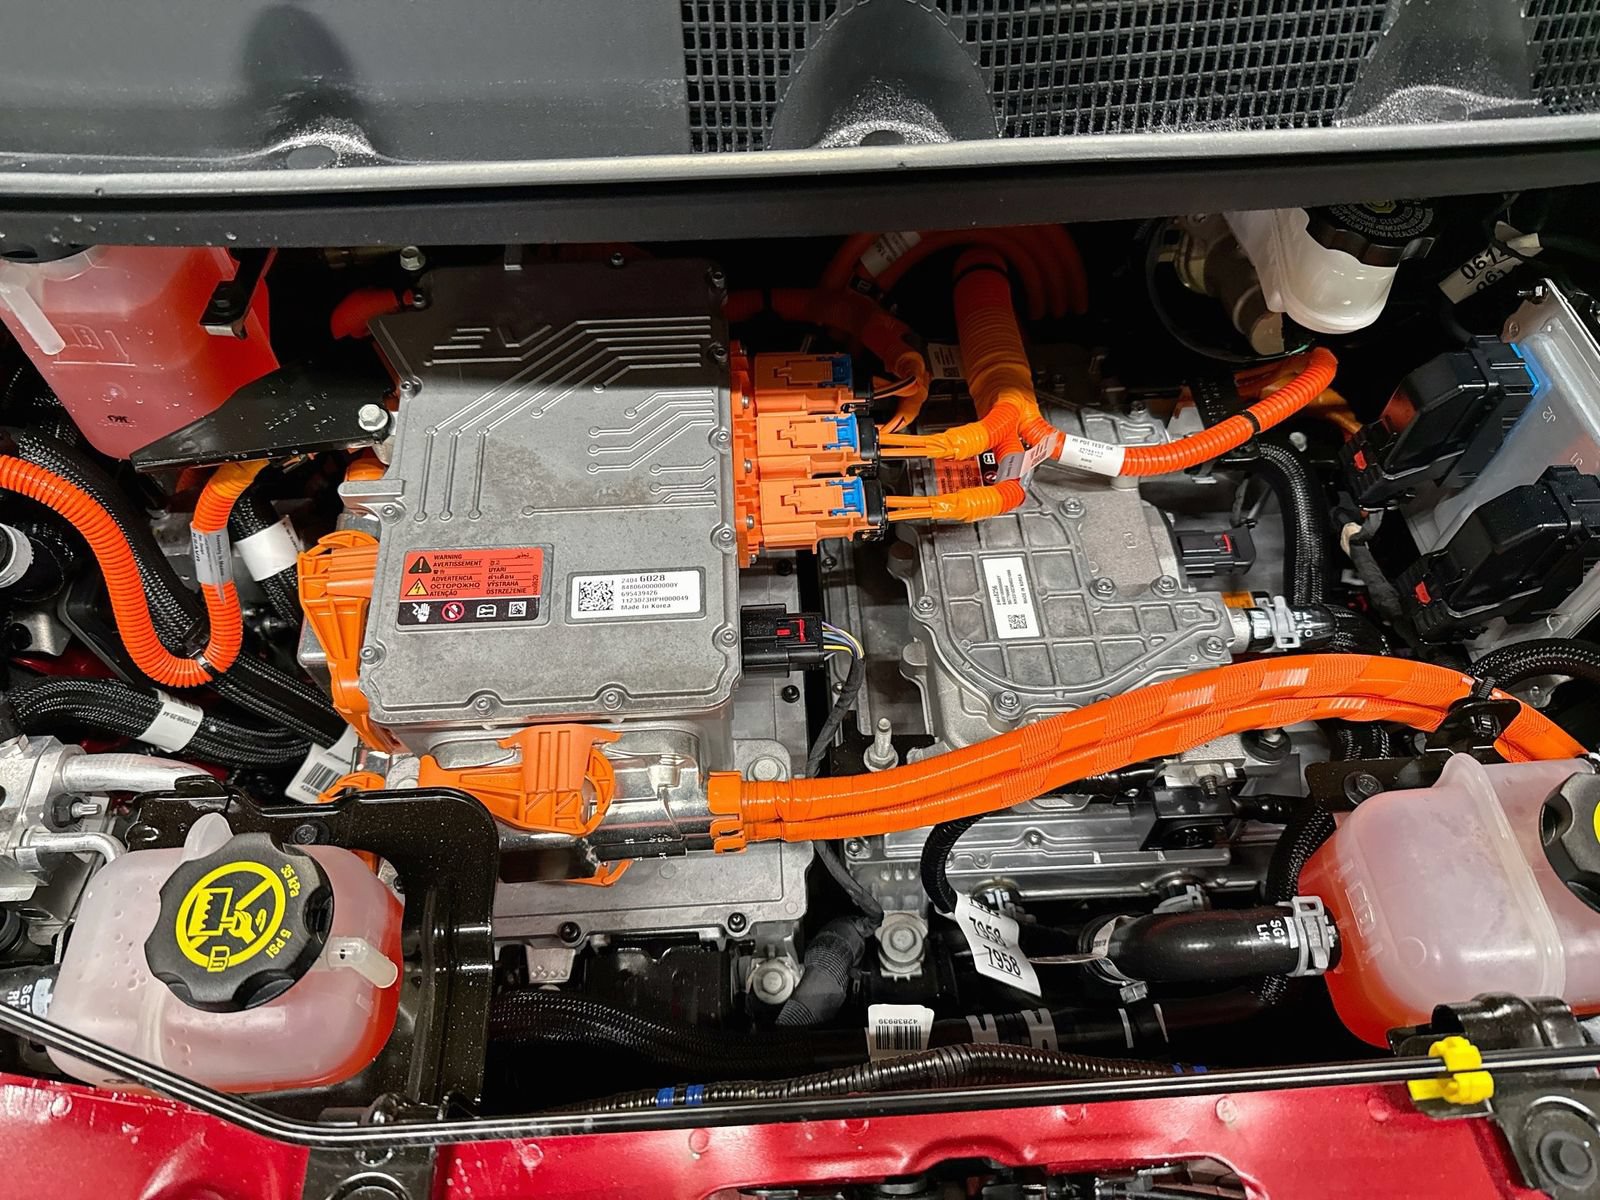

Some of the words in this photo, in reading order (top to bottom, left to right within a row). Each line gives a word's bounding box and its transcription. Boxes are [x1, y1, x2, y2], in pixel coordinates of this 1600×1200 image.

[433, 560, 482, 568] AVERTISSEMENT
[640, 574, 666, 582] 6028
[280, 864, 295, 878] 35
[287, 875, 301, 898] kPa
[280, 928, 292, 940] 5
[969, 916, 1007, 946] 7958
[1256, 924, 1270, 942] LH
[1270, 919, 1287, 946] SGT
[265, 937, 286, 959] PSI
[983, 944, 1021, 976] 7958
